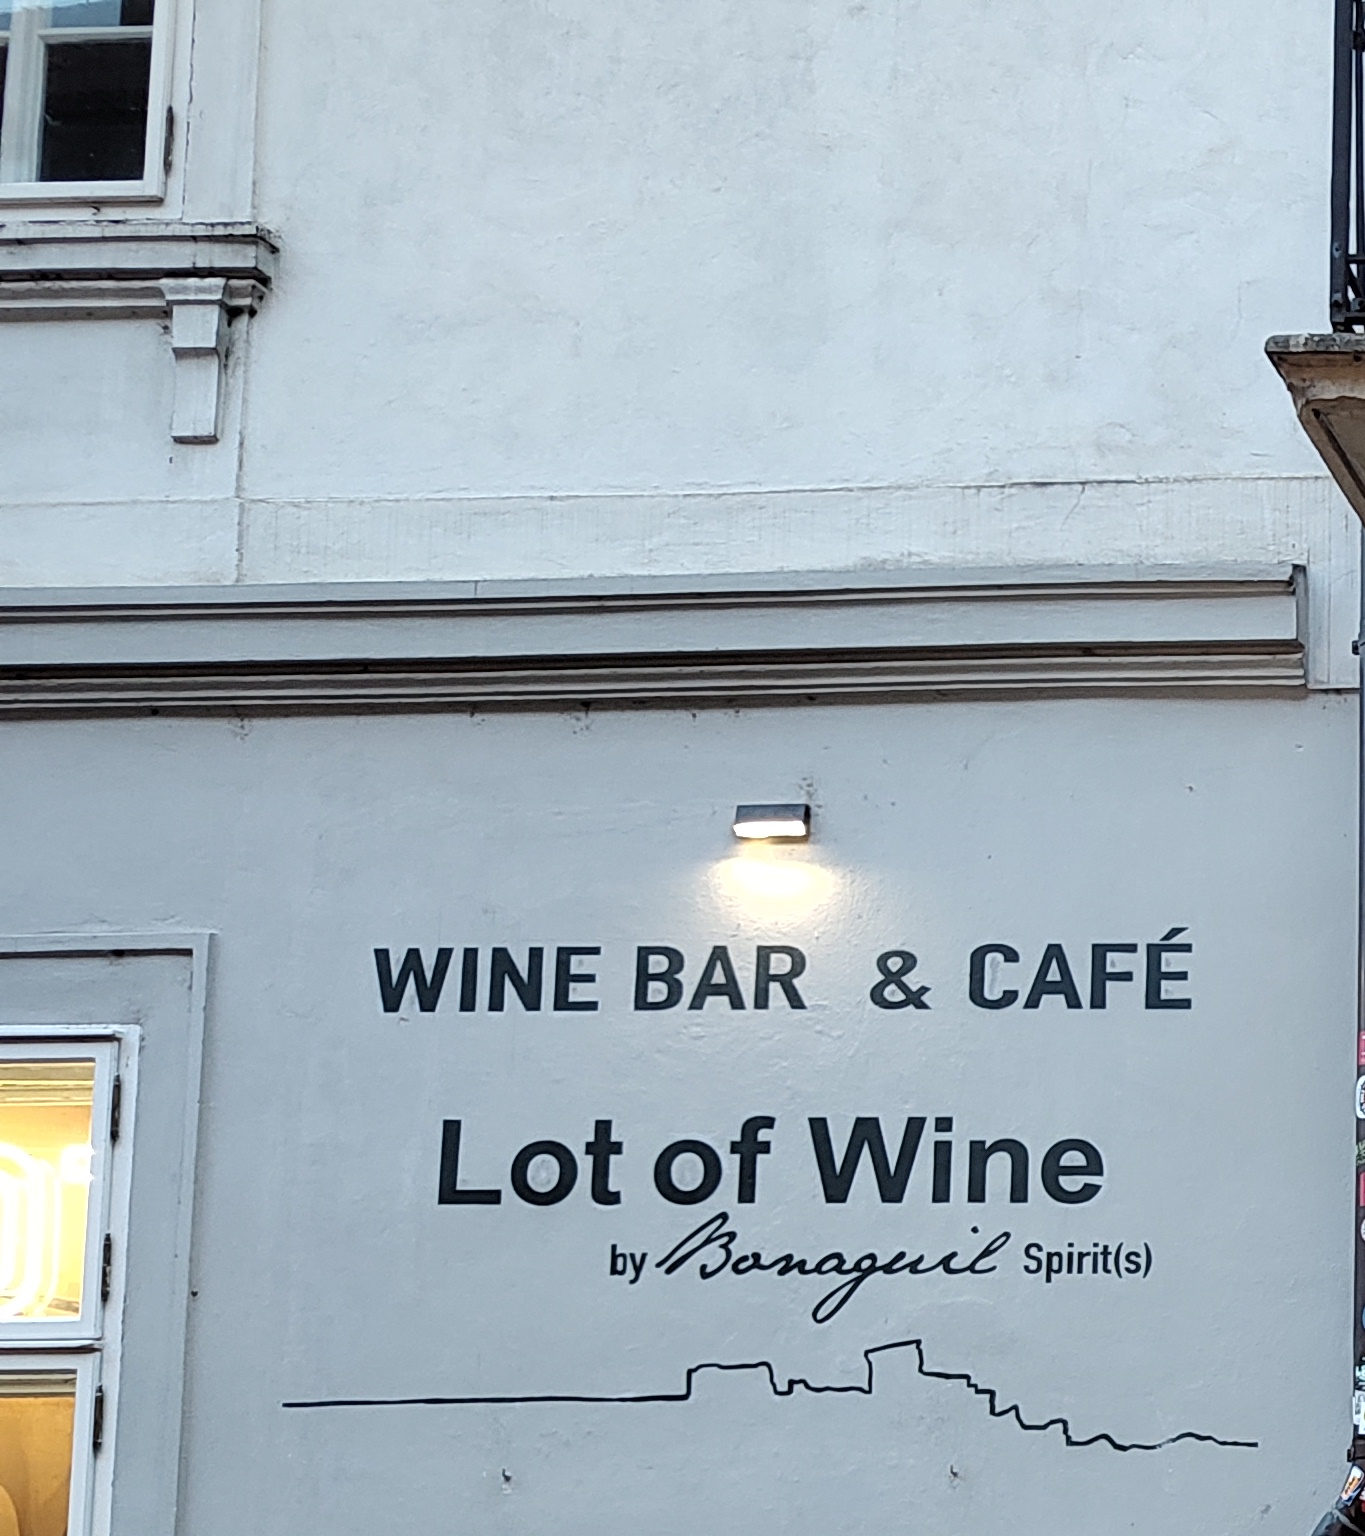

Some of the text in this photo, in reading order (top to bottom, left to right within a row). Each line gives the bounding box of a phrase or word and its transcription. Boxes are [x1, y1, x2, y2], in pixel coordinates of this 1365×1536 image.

[373, 926, 1194, 1013] WINE BAR & CAFÉ
[438, 1116, 1105, 1206] Lot of Wine
[609, 1211, 1153, 1324] by Bonaguil Spirit(s)
